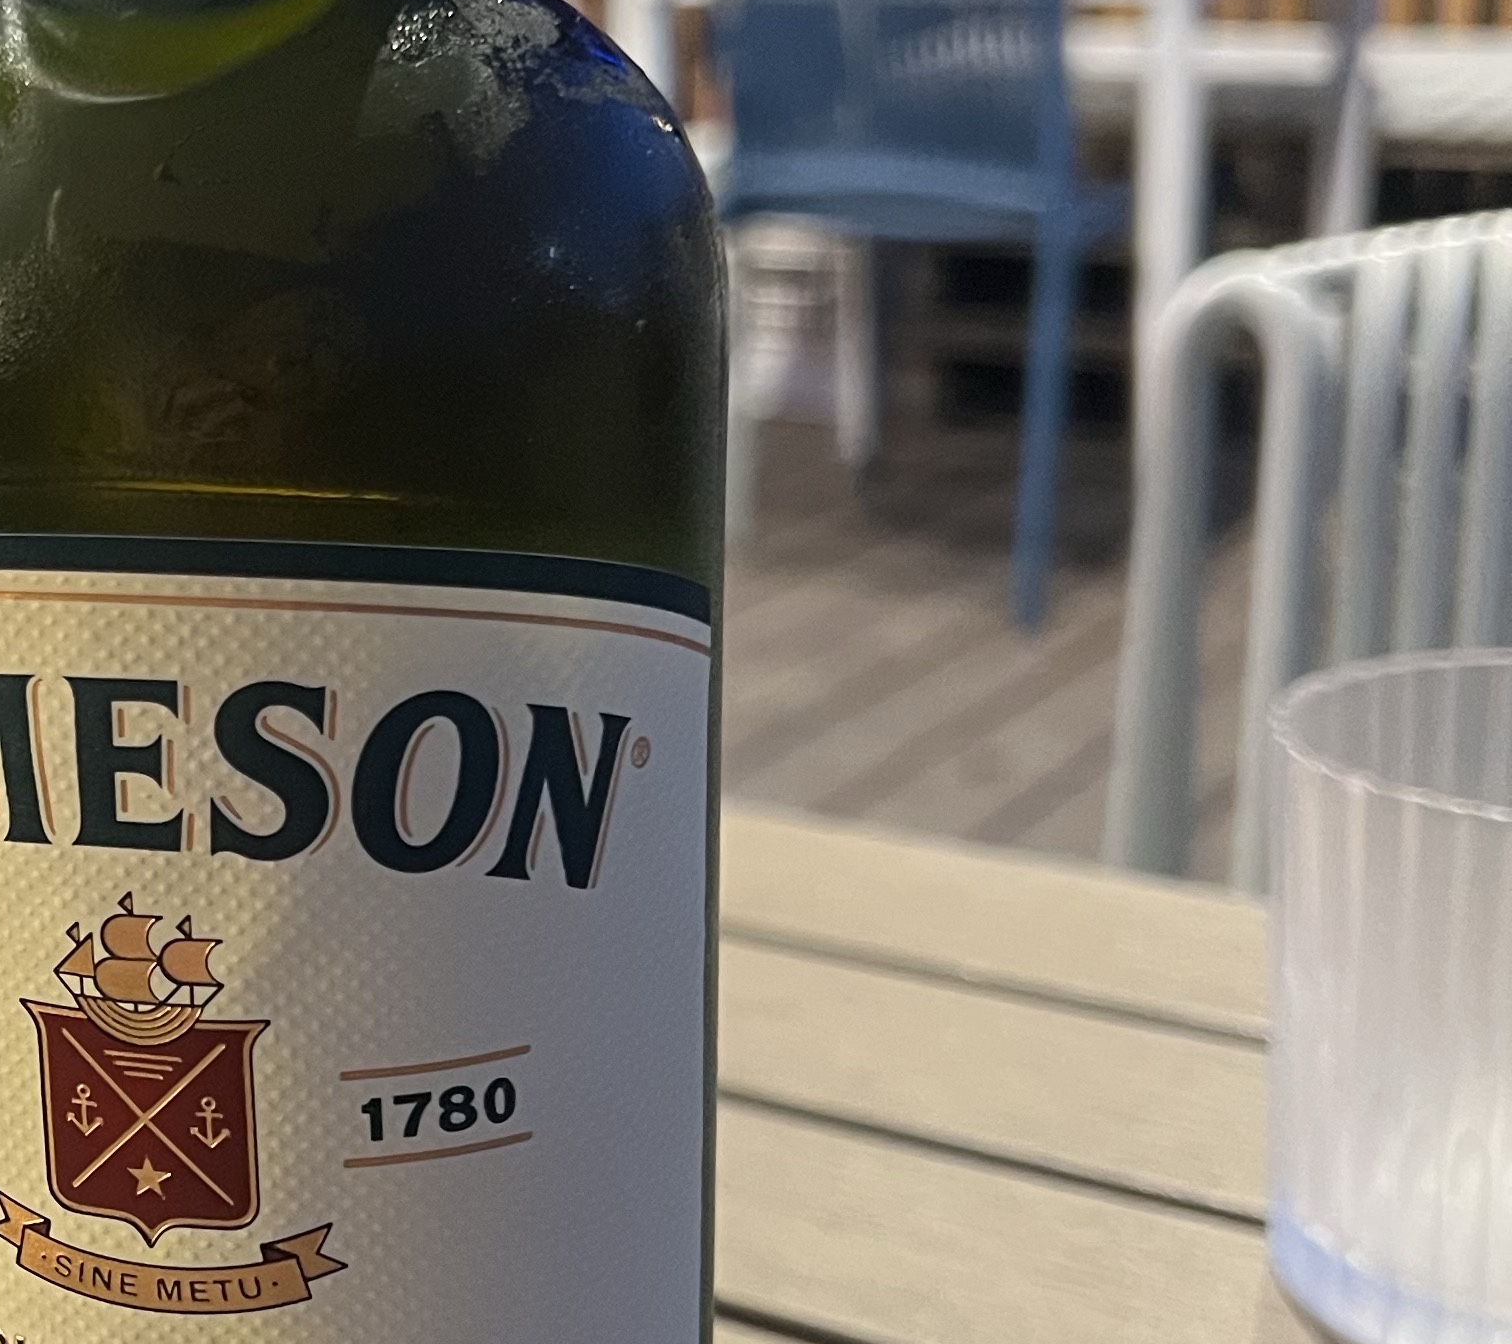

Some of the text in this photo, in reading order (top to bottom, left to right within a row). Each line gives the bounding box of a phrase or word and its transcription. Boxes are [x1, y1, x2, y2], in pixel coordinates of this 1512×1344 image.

[360, 1076, 517, 1143] 1780
[53, 1253, 263, 1304] SINE METU
